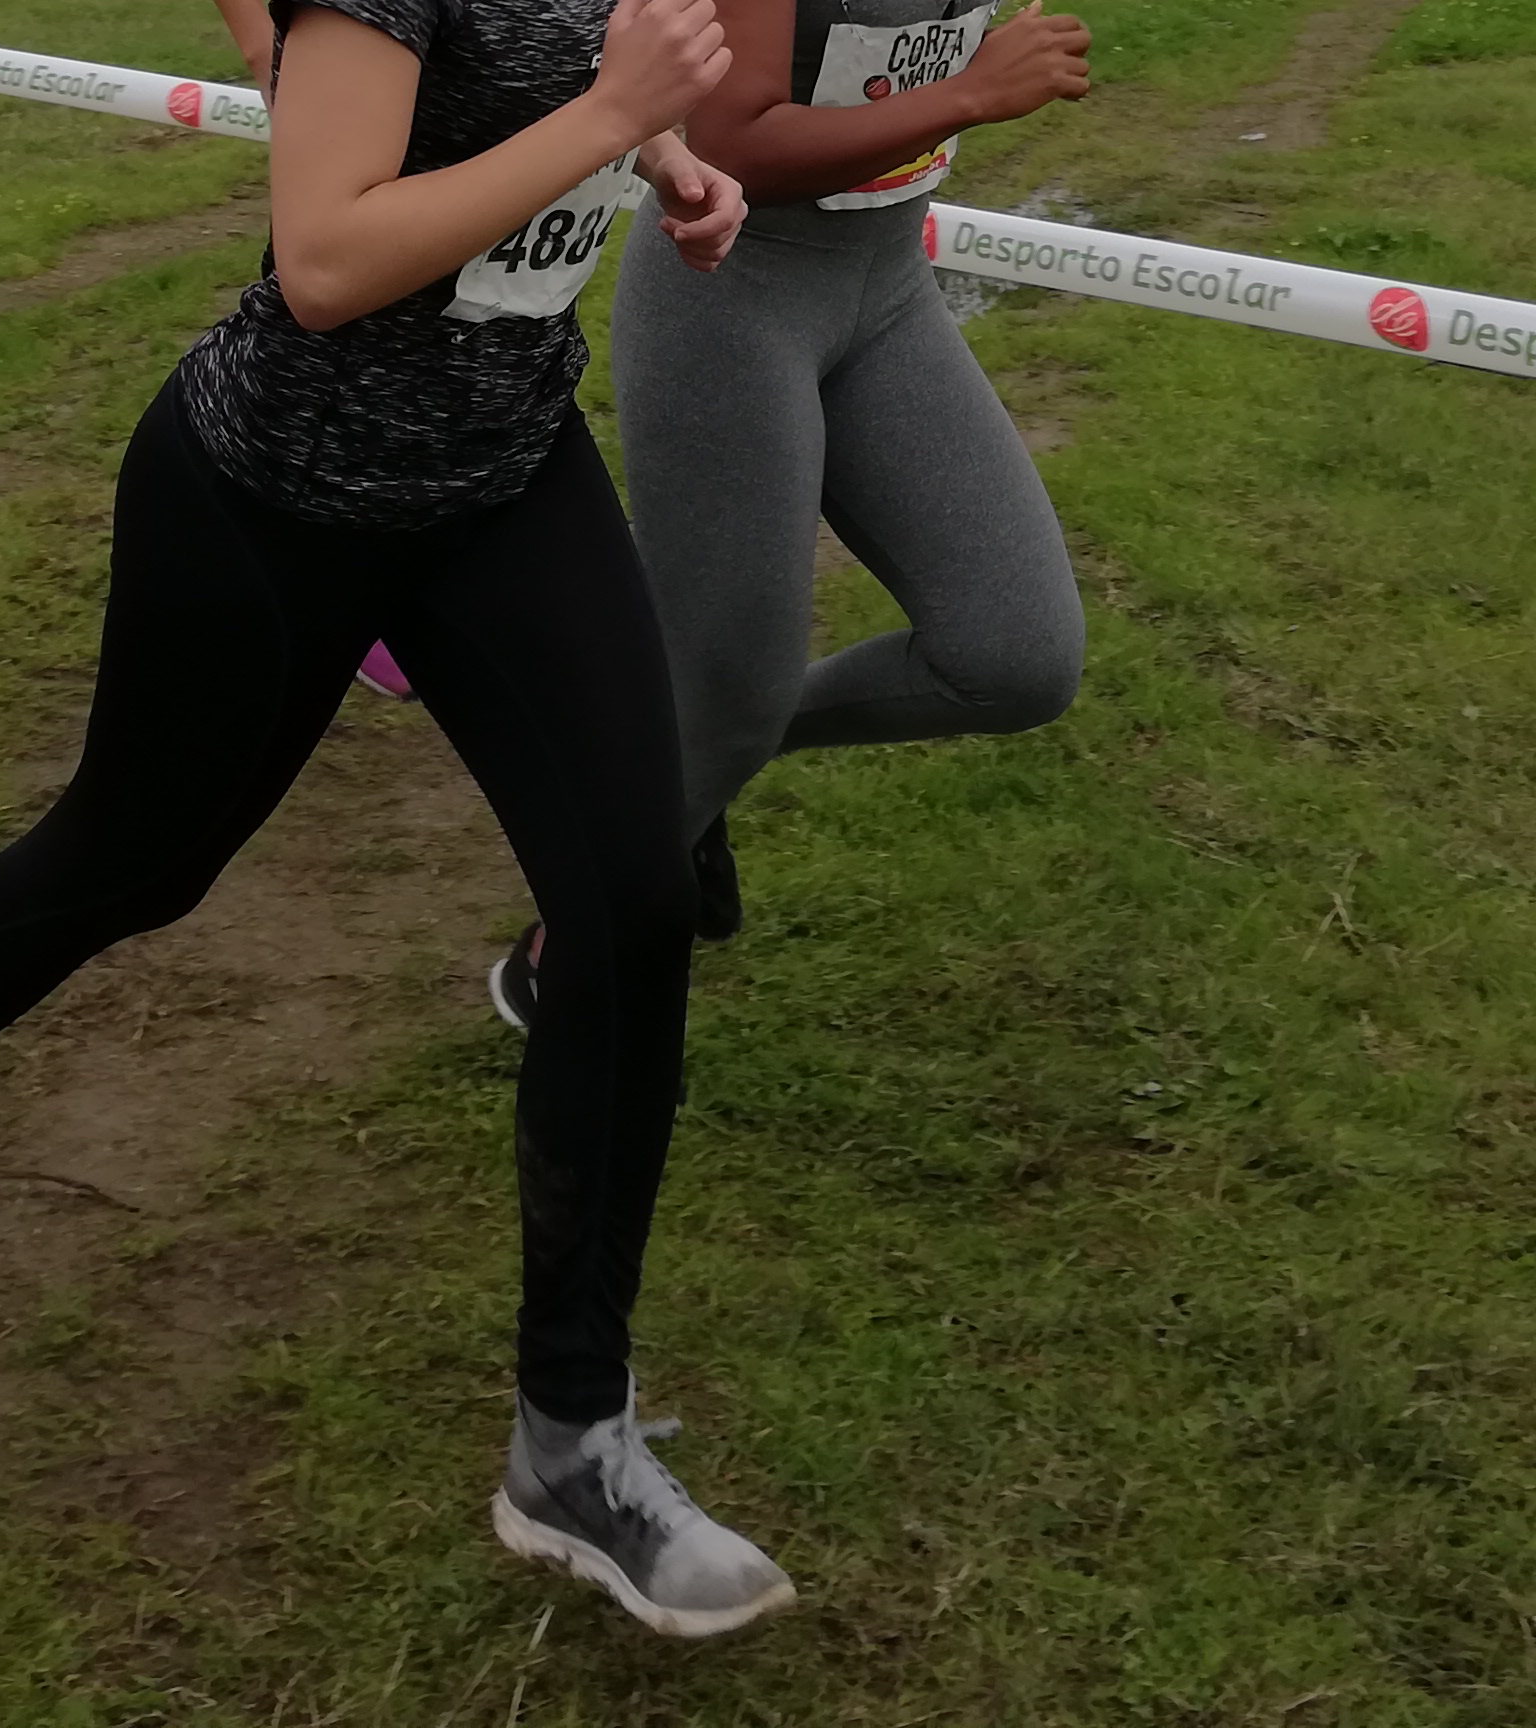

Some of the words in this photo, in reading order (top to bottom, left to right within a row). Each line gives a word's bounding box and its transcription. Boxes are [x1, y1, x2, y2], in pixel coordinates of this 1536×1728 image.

[887, 24, 965, 73] CORTA
[29, 65, 128, 103] Escolar
[898, 59, 950, 92] MATO
[953, 221, 1121, 283] Desporto
[1131, 254, 1293, 312] Escolar
